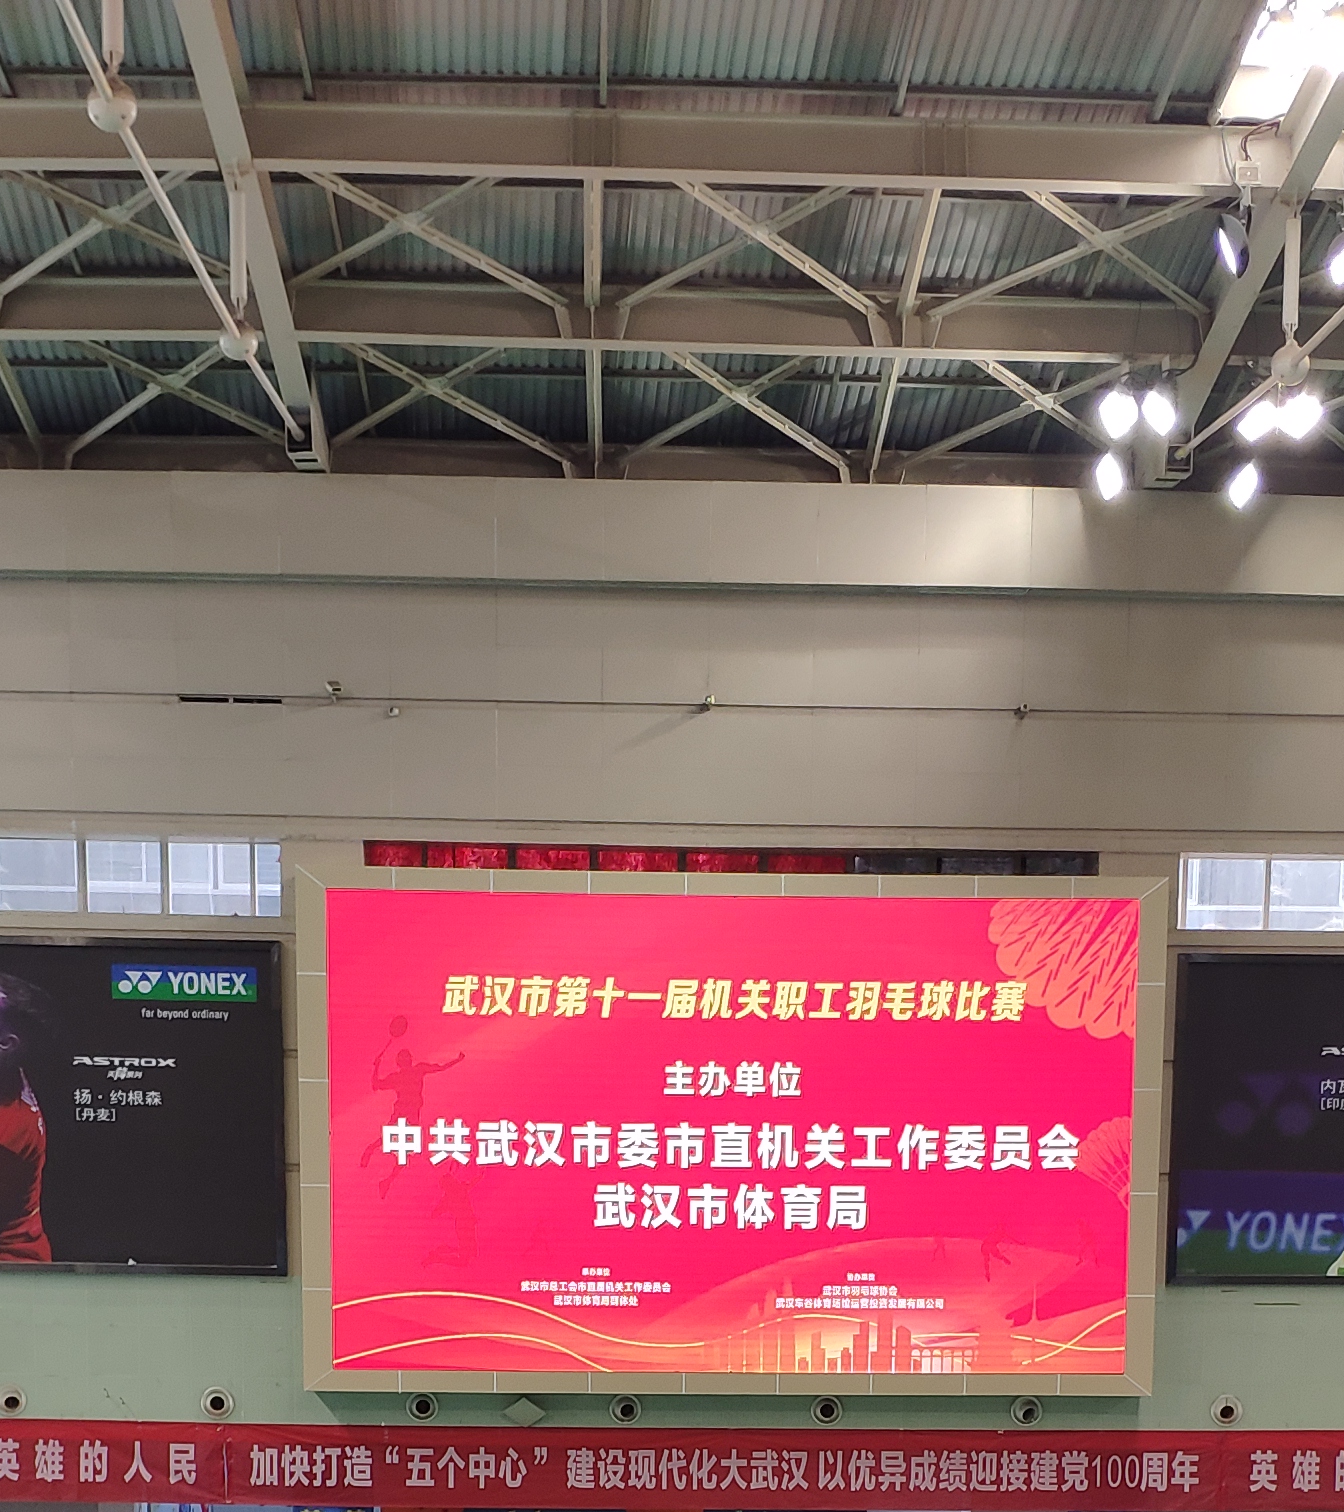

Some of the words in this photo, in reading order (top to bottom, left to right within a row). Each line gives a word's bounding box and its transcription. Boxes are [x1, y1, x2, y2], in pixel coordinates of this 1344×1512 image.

[167, 971, 247, 995] YONEX
[442, 974, 1027, 1023] 武汉市第十一届机关职工羽毛球比赛
[141, 1008, 154, 1018] far
[157, 1008, 188, 1020] beyond
[192, 1009, 229, 1022] ordinary
[72, 1056, 177, 1067] ASTROX
[663, 1060, 802, 1098] 主办单位
[74, 1088, 162, 1106] 扬·约根森
[382, 1120, 1080, 1171] 中共武汉市委市直机关工作委员会
[593, 1183, 869, 1230] 武汉市体育局
[567, 1447, 809, 1492] 建设现代化大武汉
[817, 1449, 1200, 1493] 以优异成绩迎接建党100周年
